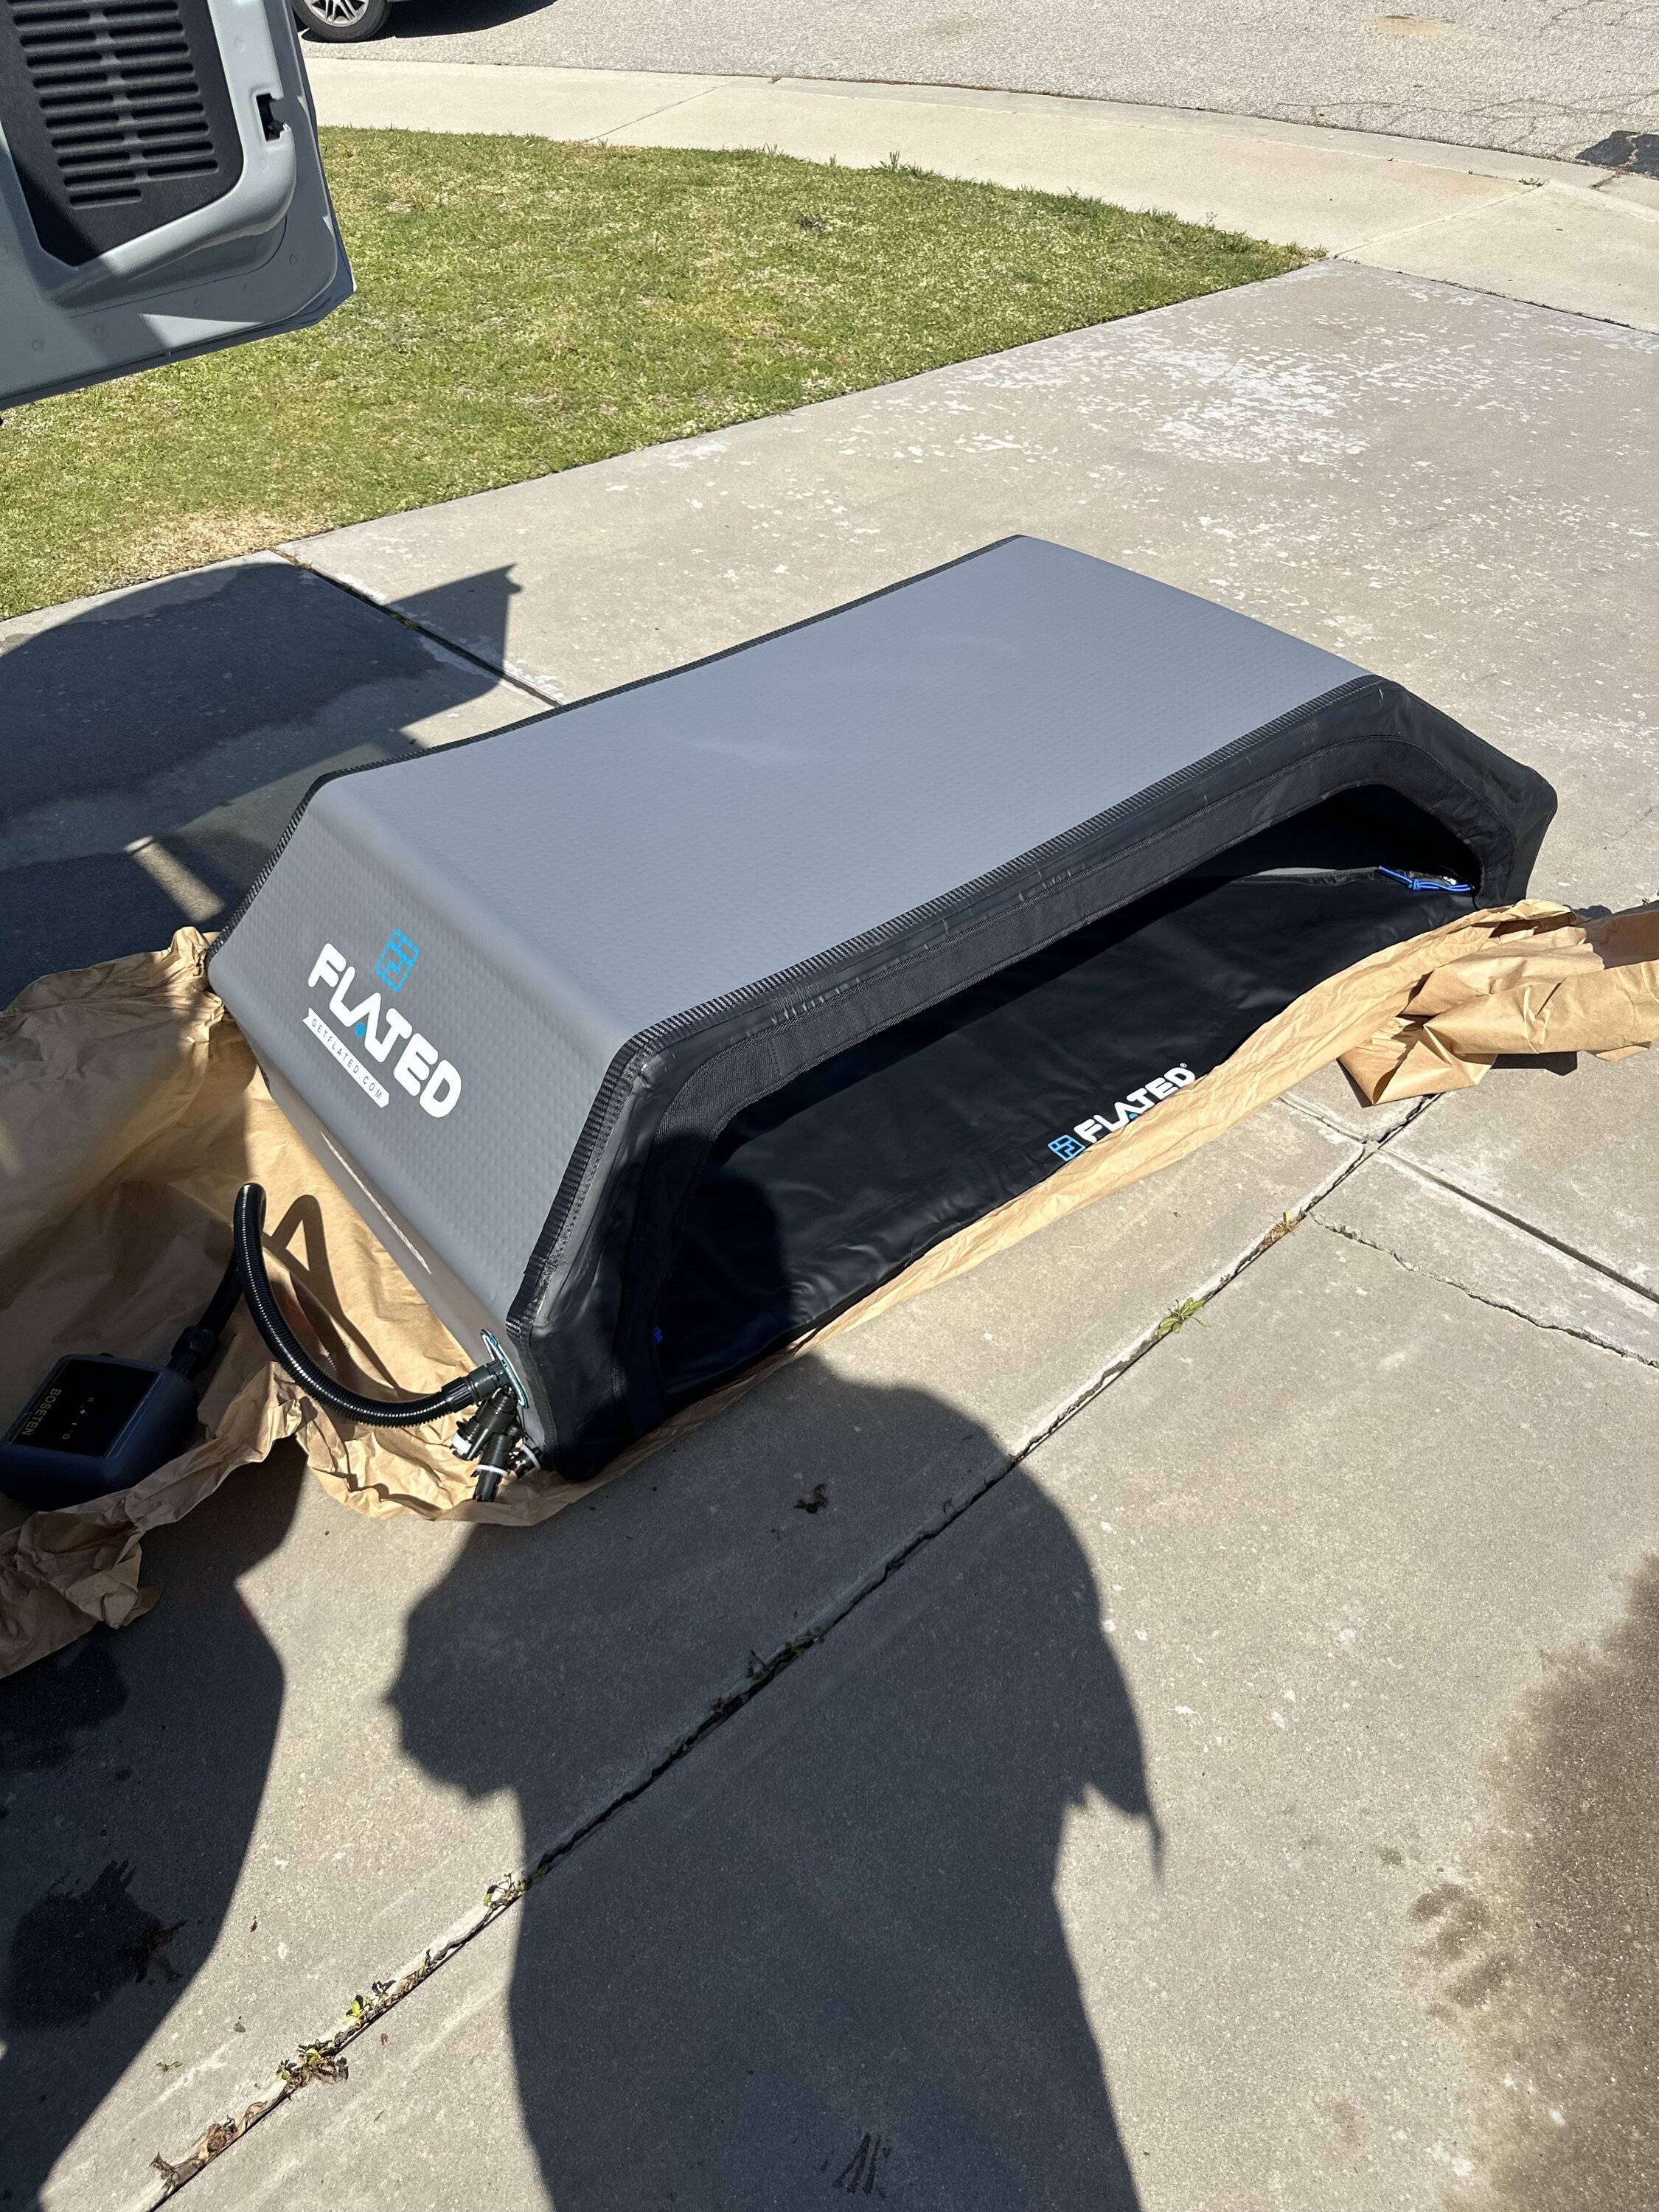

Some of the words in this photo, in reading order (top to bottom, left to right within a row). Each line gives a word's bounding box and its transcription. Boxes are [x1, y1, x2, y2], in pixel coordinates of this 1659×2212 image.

[307, 942, 462, 1119] FLATED
[311, 1018, 383, 1099] GETFLATED.COM
[21, 1388, 62, 1436] BOSETEN
